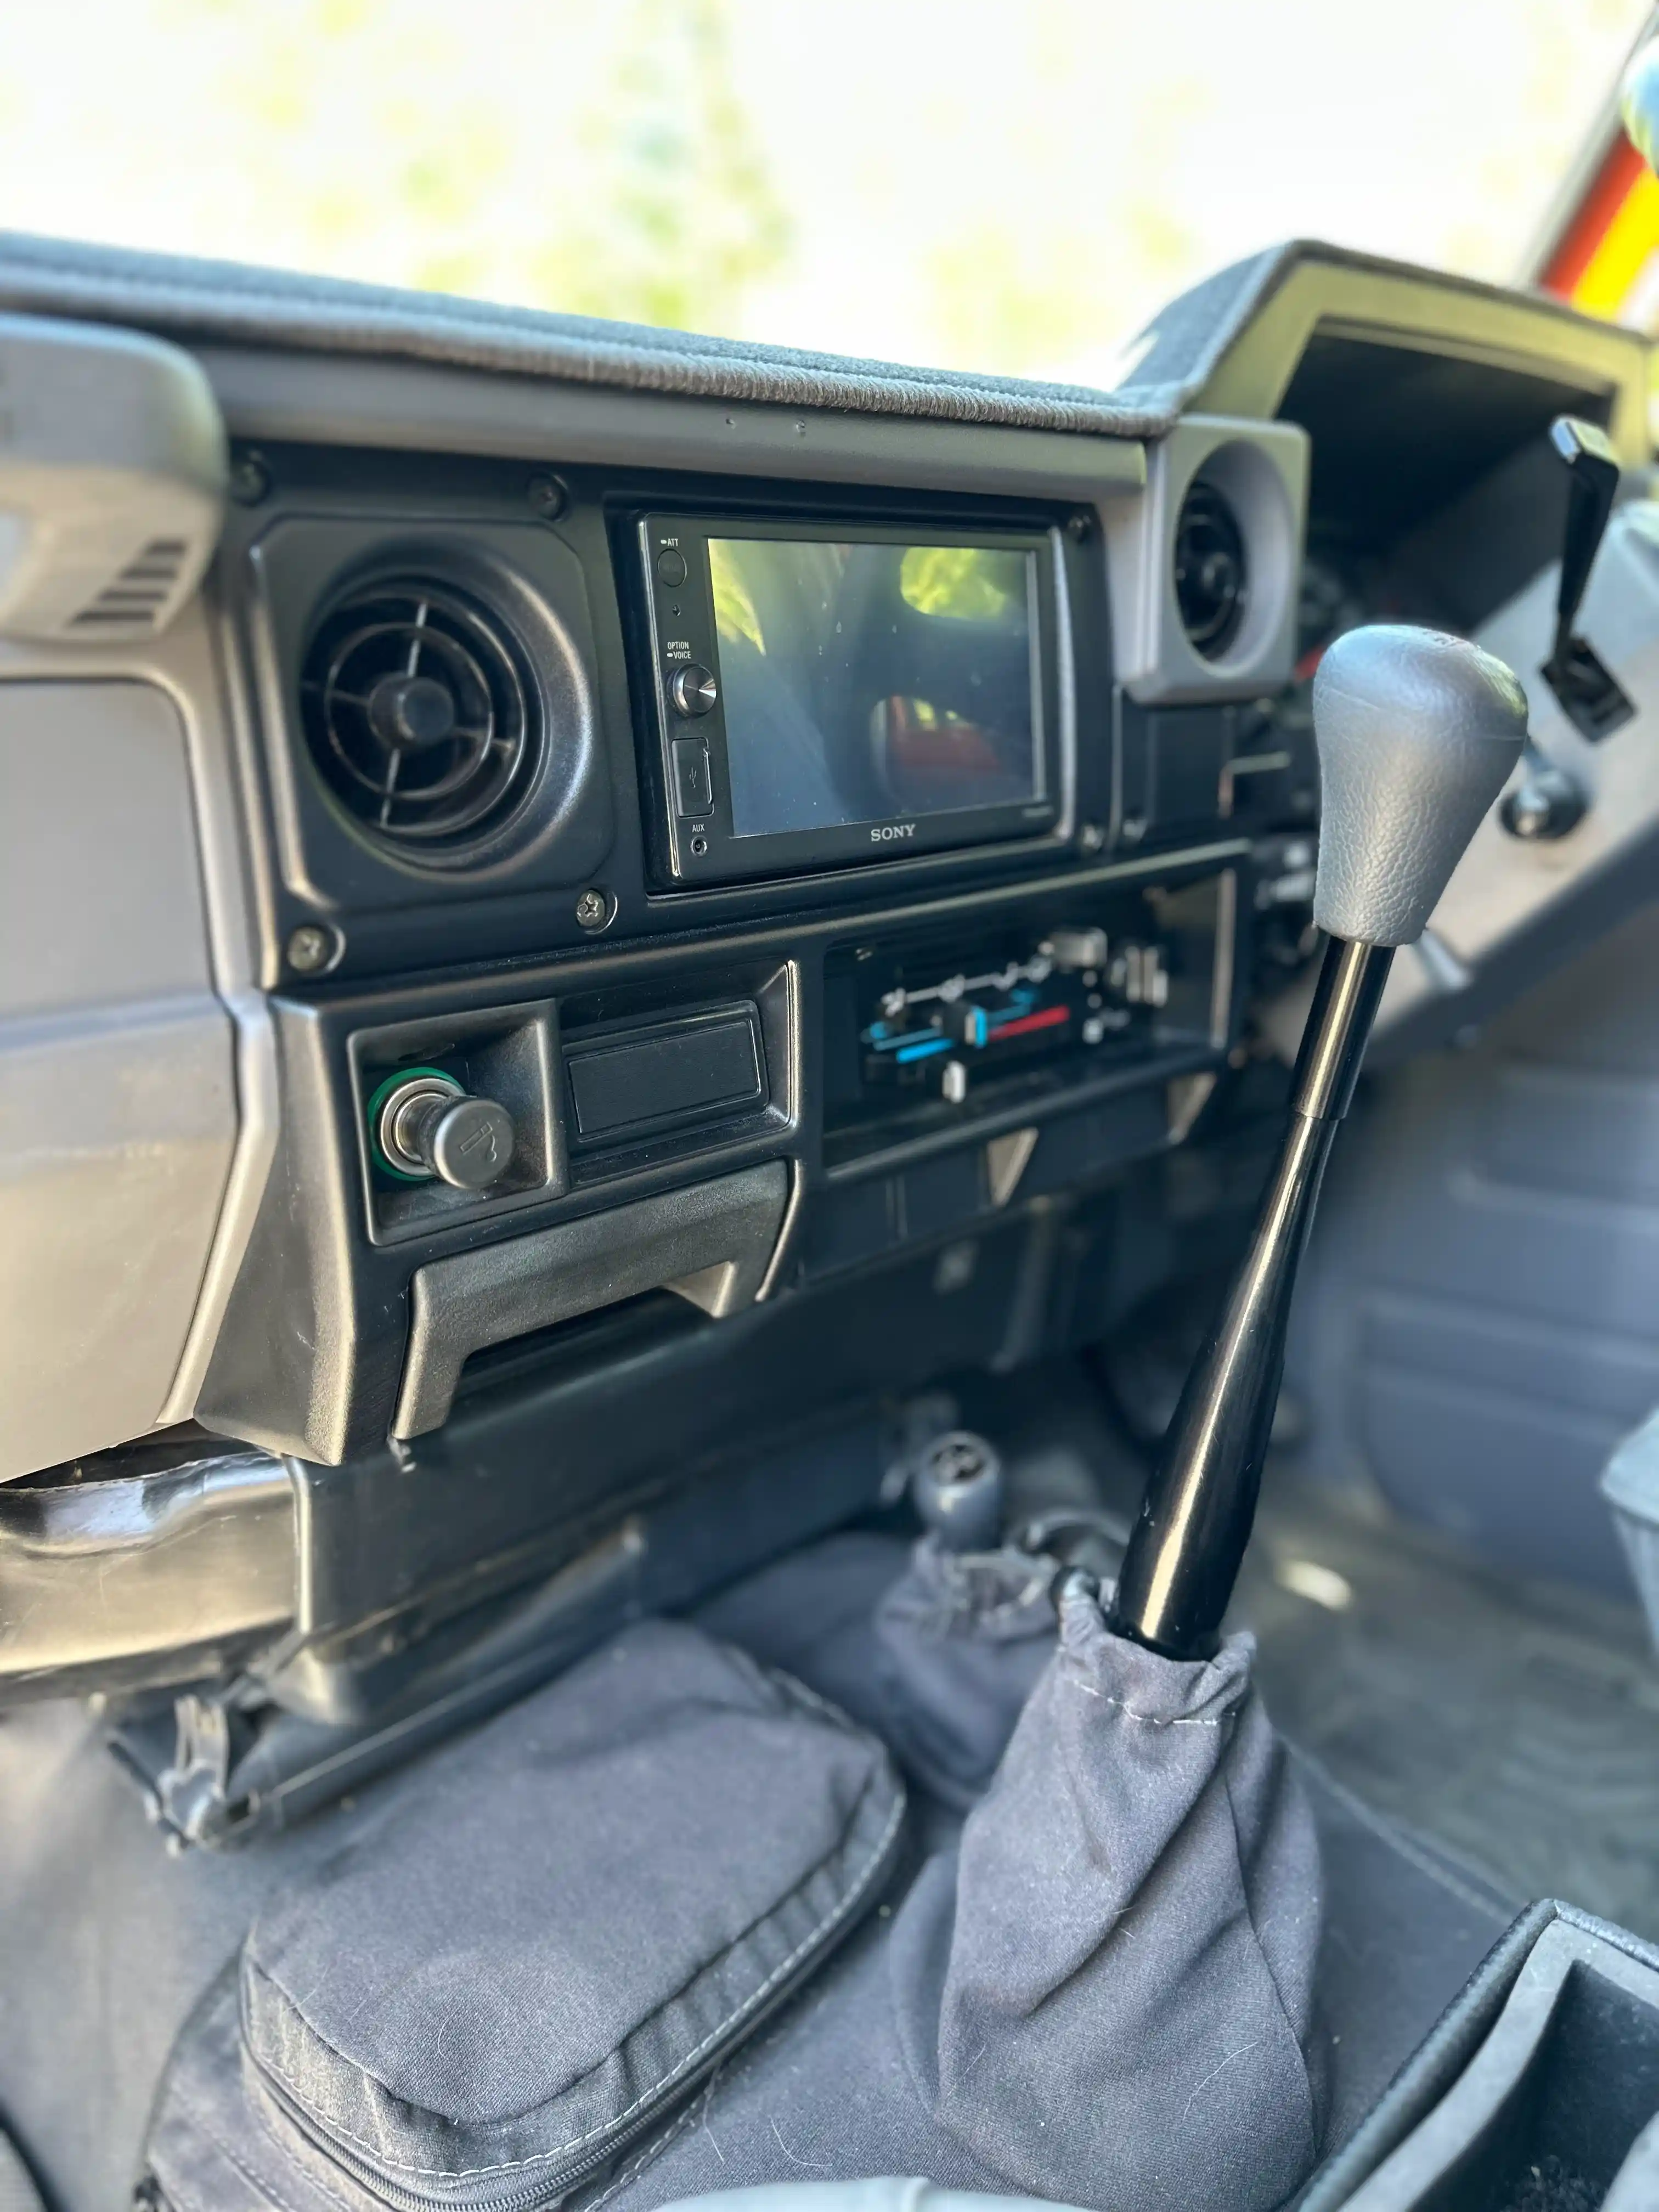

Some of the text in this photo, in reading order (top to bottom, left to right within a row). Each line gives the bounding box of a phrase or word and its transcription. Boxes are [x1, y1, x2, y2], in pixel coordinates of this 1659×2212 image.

[667, 538, 679, 547] ATT
[667, 641, 690, 650] OPTION
[673, 651, 691, 659] VOICE
[692, 823, 706, 833] AUX
[871, 823, 916, 842] SONY
